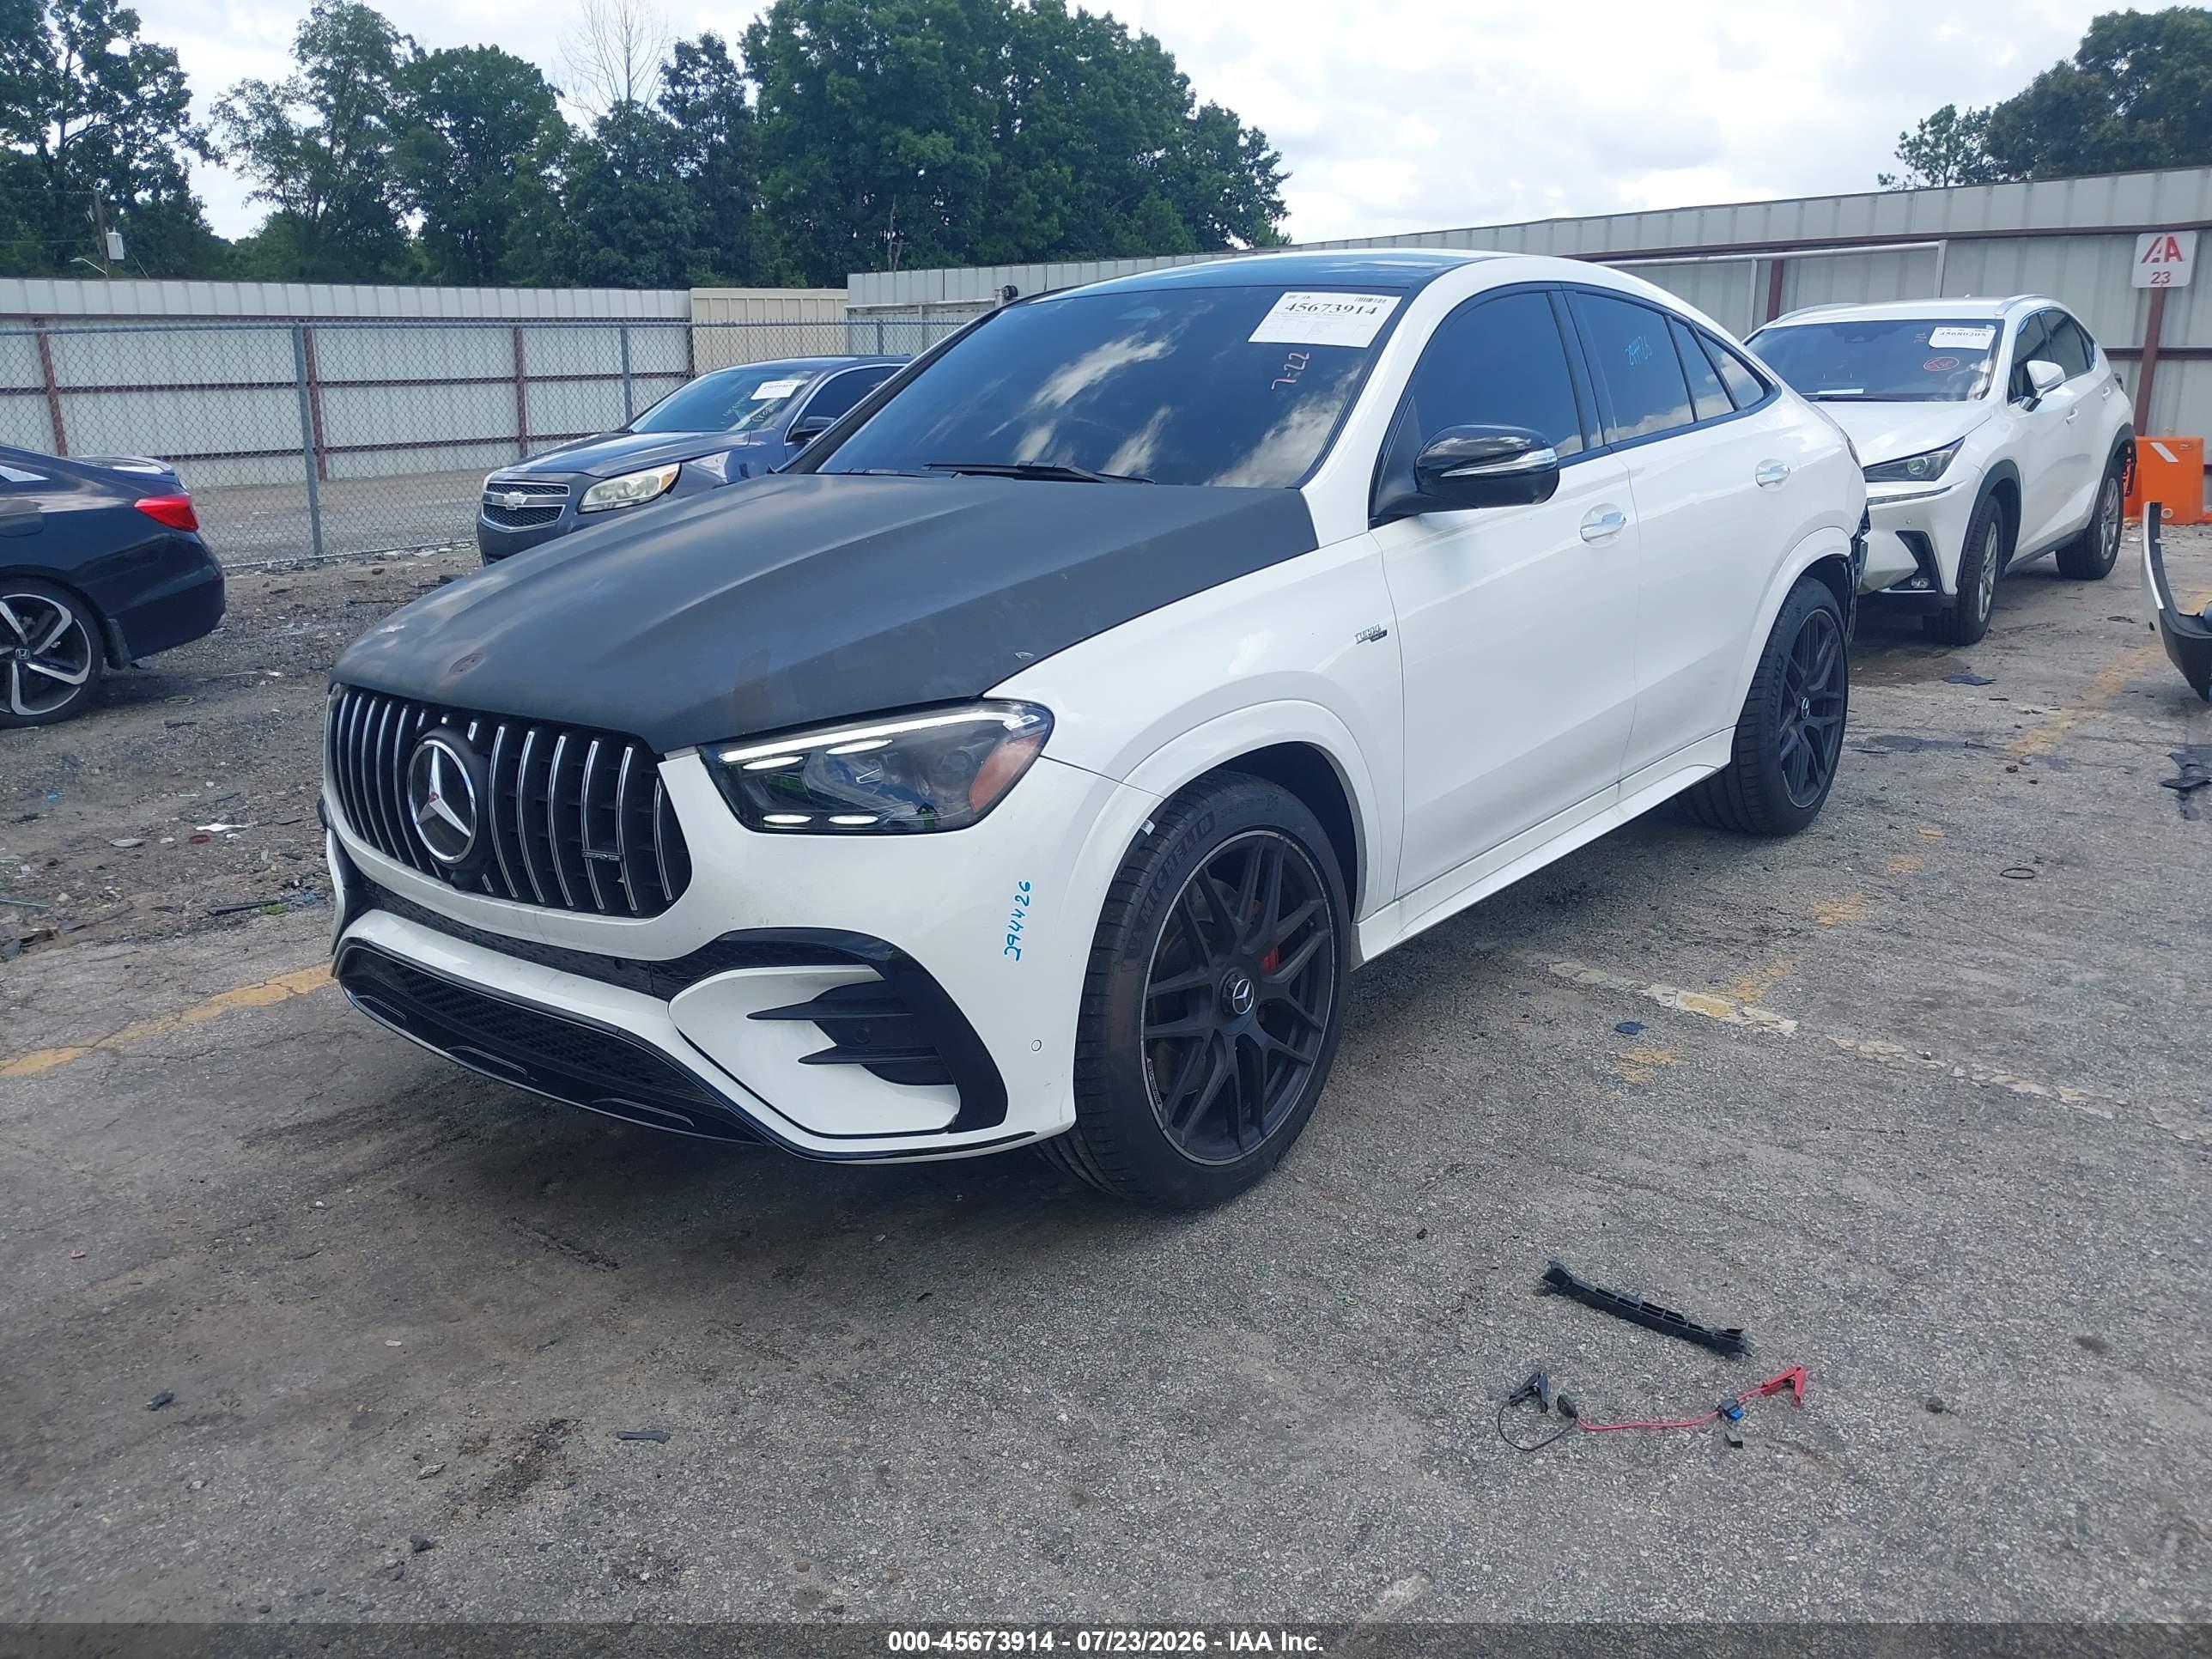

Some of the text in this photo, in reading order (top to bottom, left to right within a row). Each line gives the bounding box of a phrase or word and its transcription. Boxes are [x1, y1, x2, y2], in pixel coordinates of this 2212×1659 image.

[2150, 270, 2171, 284] 23
[1284, 302, 1378, 316] 45673914
[1139, 809, 1217, 924] MICHELIN
